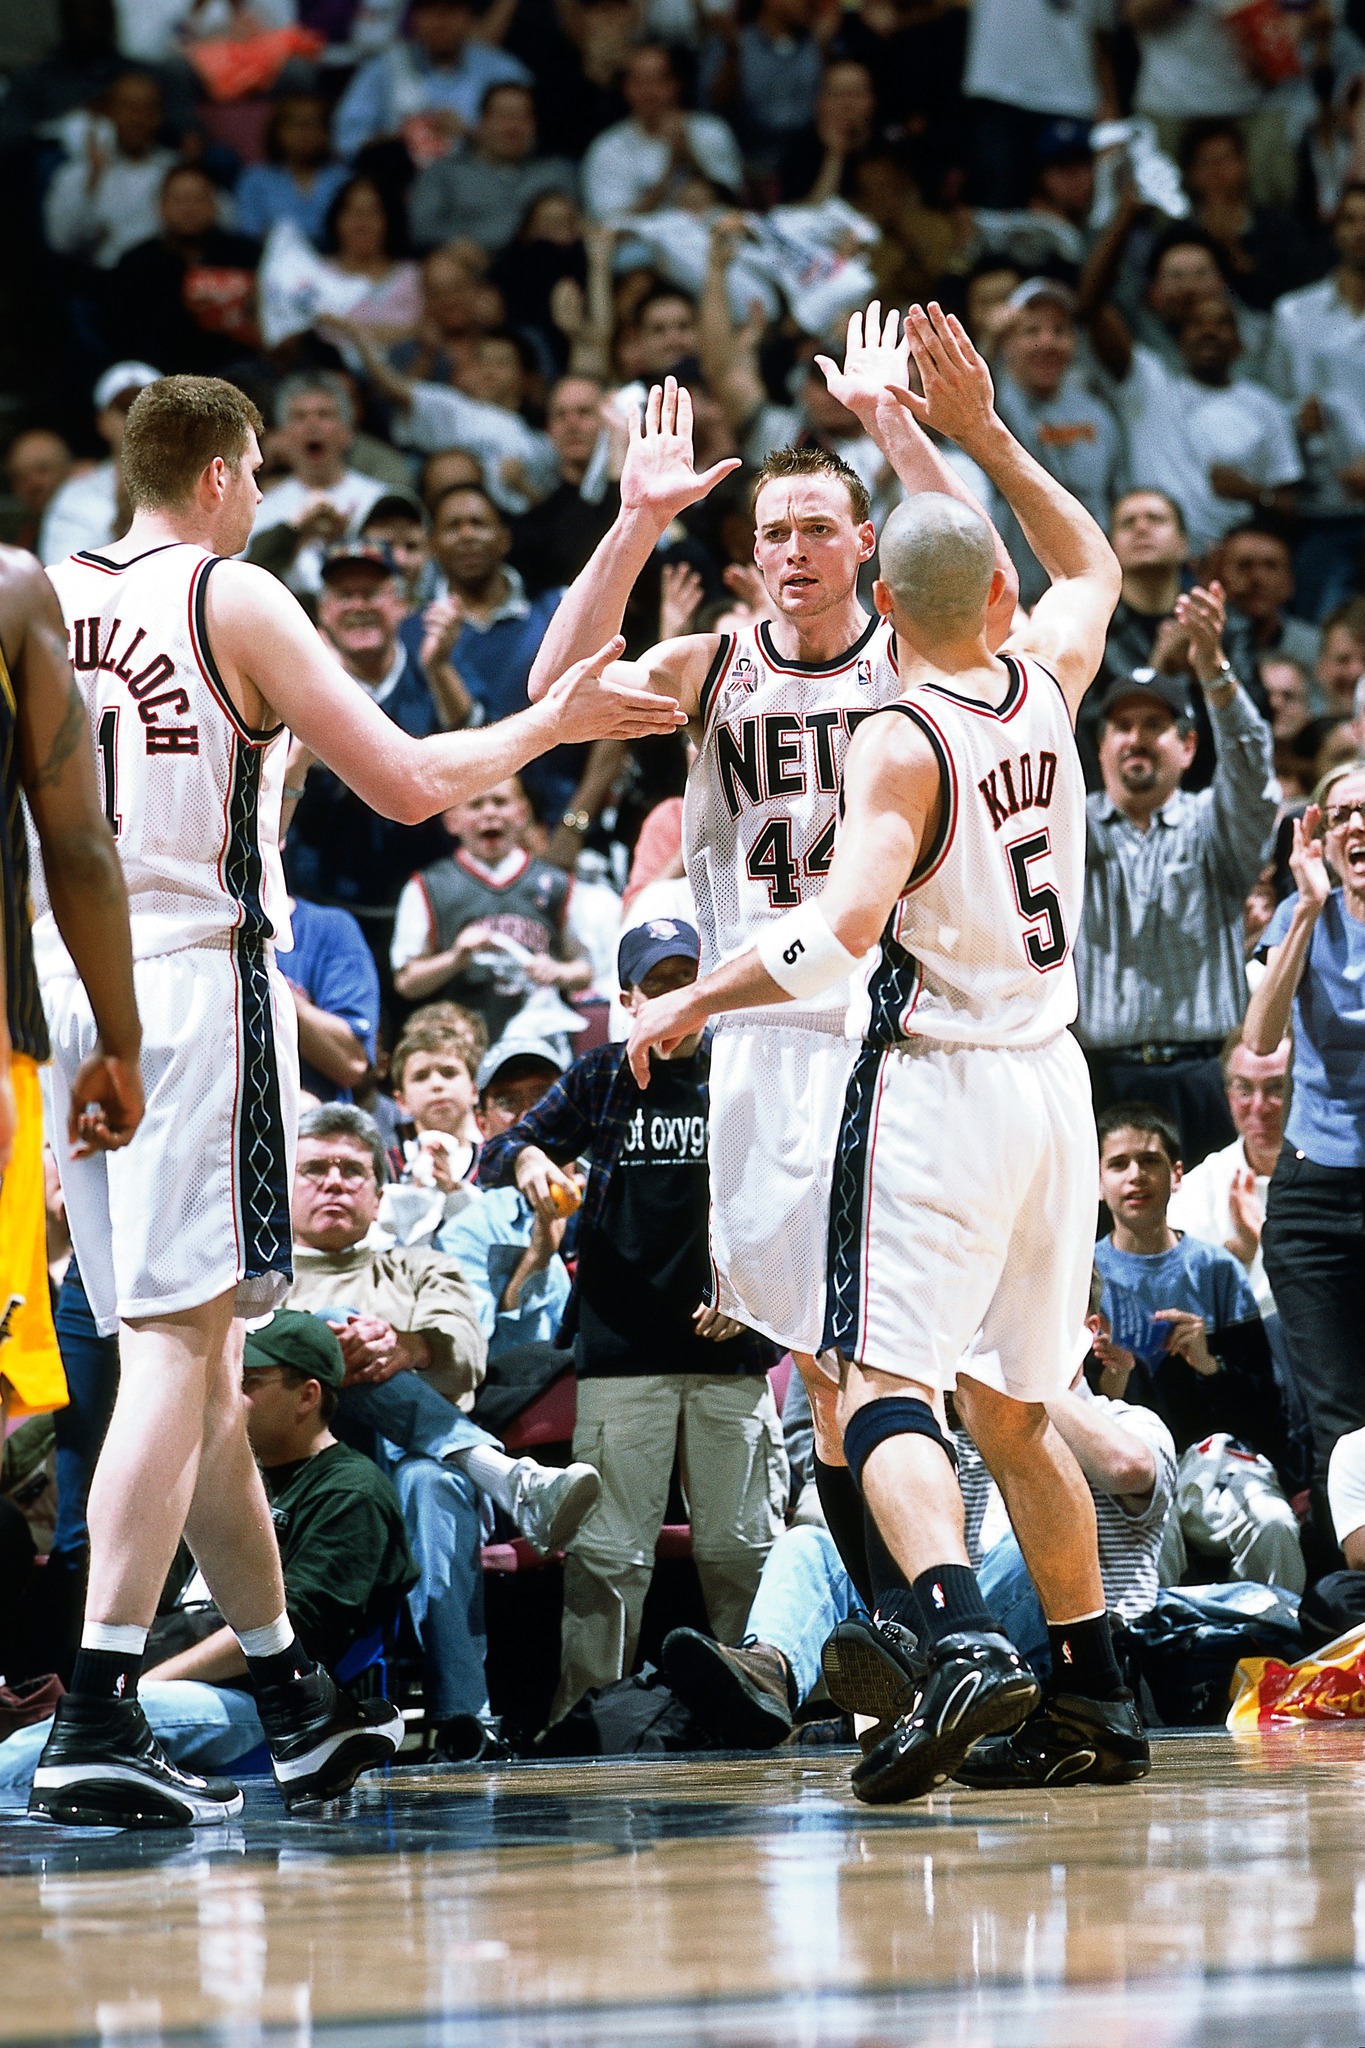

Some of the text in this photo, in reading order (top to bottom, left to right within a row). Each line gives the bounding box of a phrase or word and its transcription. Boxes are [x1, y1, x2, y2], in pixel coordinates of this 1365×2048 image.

[67, 617, 199, 756] ULLOCH
[978, 751, 1057, 832] KIDD
[1005, 826, 1070, 974] 5
[783, 939, 805, 965] 5
[618, 1108, 709, 1158] ot oxyg
